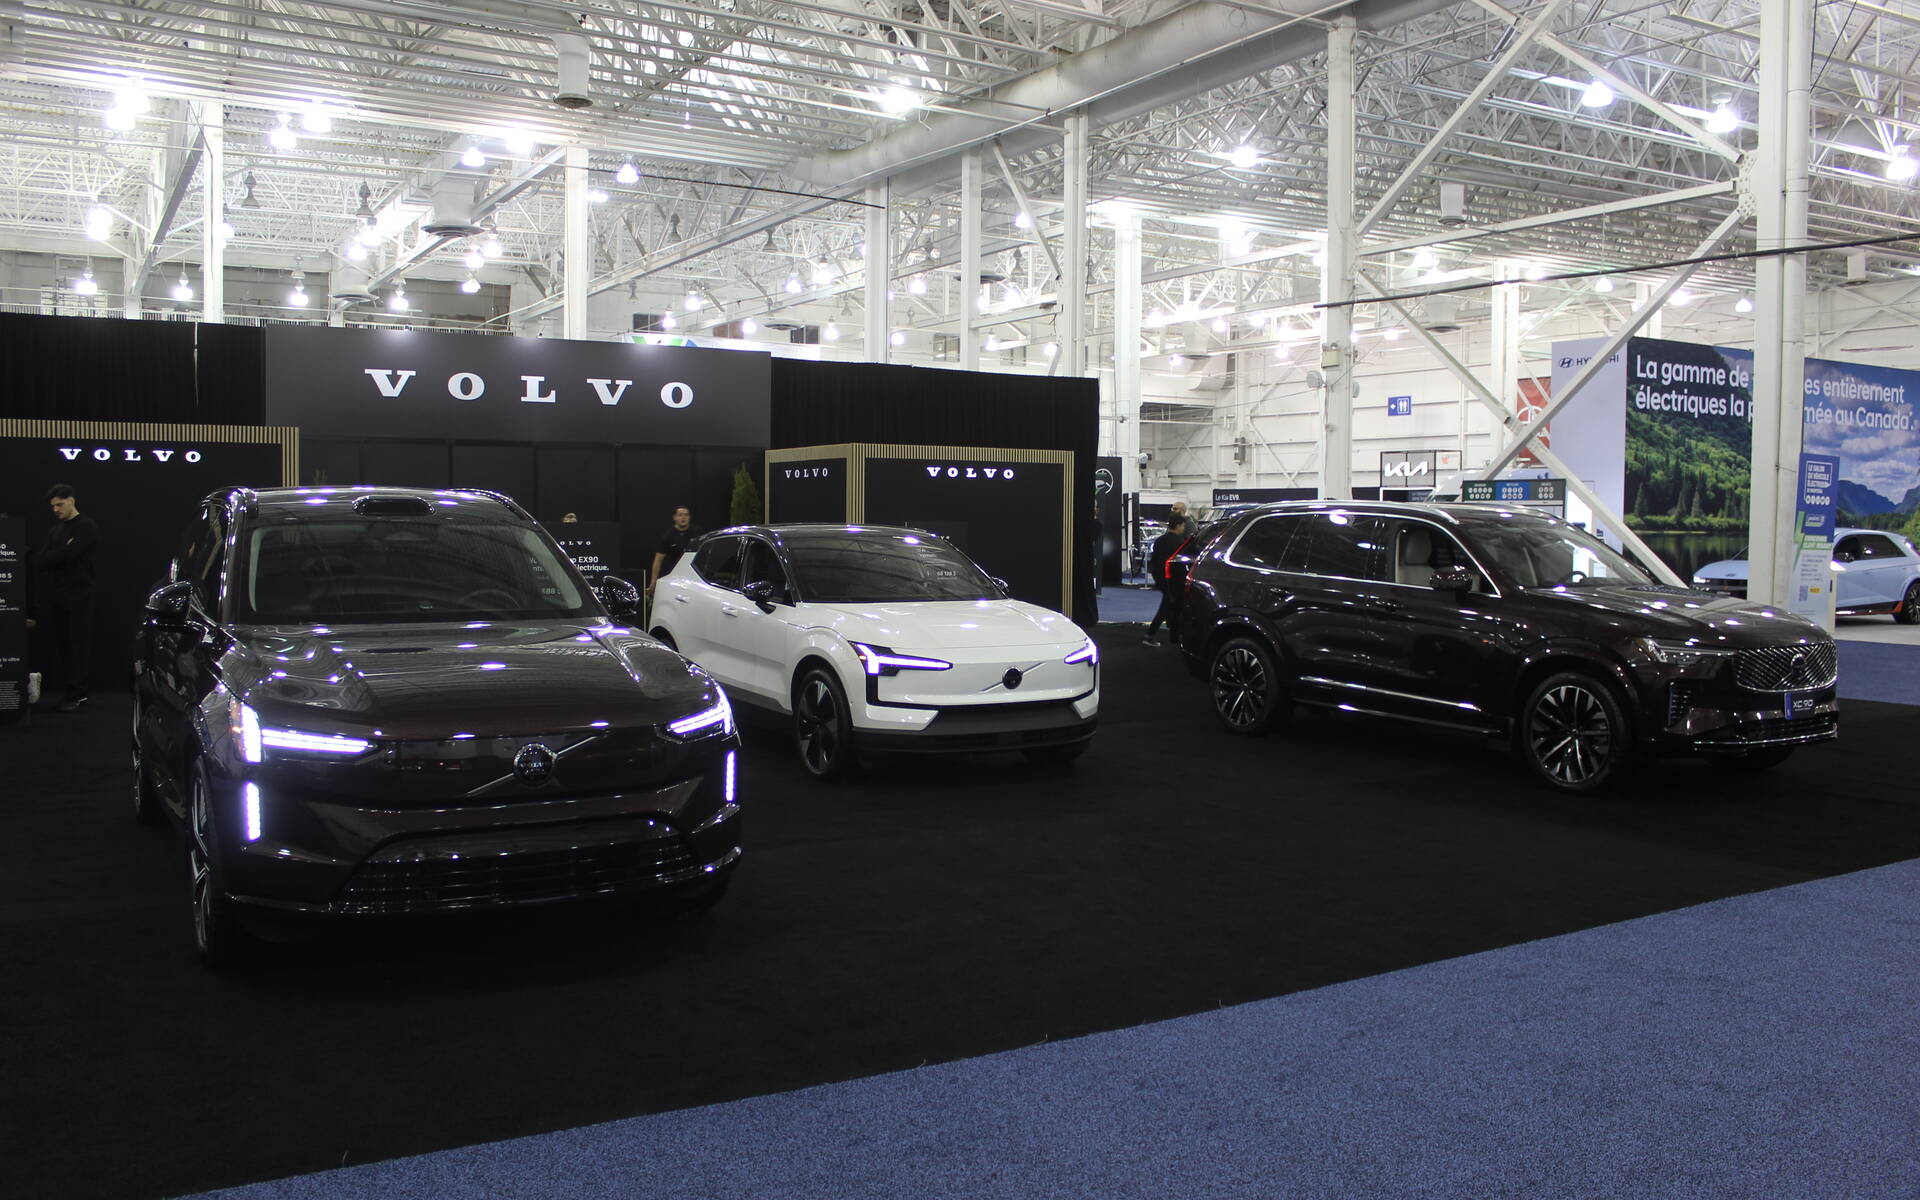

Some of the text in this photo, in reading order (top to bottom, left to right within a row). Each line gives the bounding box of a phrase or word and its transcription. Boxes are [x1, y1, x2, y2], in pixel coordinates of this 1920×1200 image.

[1576, 354, 1619, 366] HYAI
[1636, 354, 1657, 379] La
[1661, 360, 1726, 387] gamme
[1729, 365, 1749, 387] de
[1823, 376, 1904, 404] entièrement
[364, 368, 694, 409] VOLVO
[1635, 385, 1727, 418] électriques
[1730, 394, 1744, 416] la
[1804, 401, 1832, 422] mée
[1835, 408, 1853, 425] au
[59, 448, 201, 463] VOLVO
[785, 467, 829, 479] VOLVO
[926, 466, 1014, 479] VOLVO
